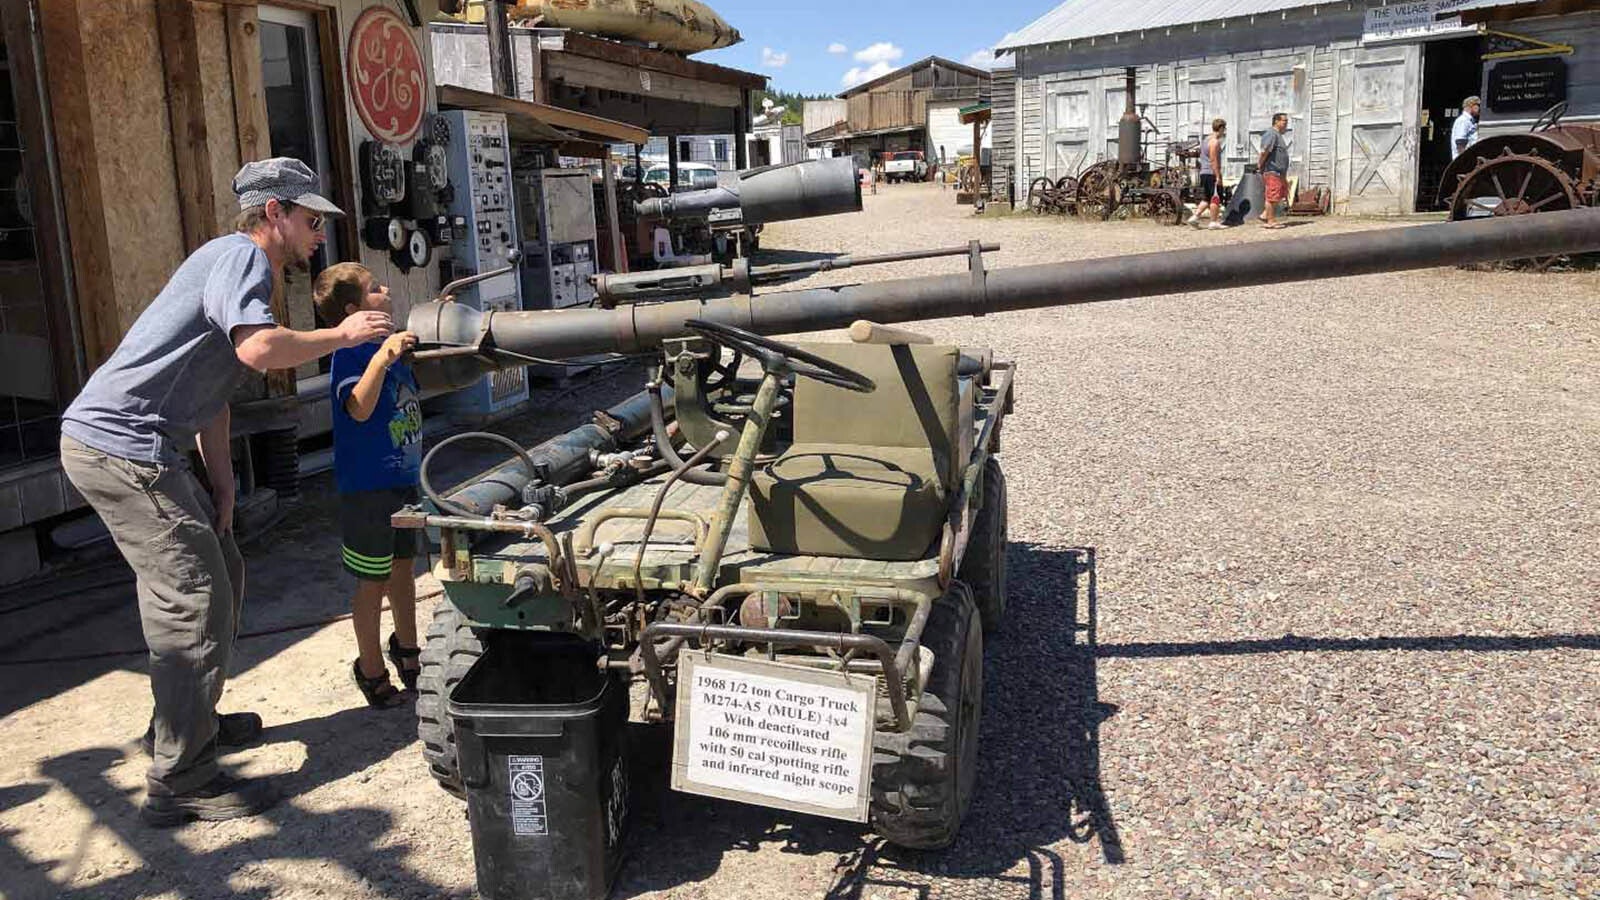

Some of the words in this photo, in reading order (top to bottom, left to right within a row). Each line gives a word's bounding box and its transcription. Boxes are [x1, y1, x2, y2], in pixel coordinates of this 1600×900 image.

[1373, 9, 1390, 18] THE
[1395, 5, 1430, 16] VILLAGE
[698, 676, 725, 690] 1968
[730, 681, 747, 694] 1/2
[752, 686, 771, 698] ton
[776, 689, 814, 706] Cargo
[818, 696, 858, 712] Truck
[703, 693, 760, 712] M274-A5
[768, 704, 821, 724] (MULE)
[826, 714, 848, 727] 4x4
[709, 726, 729, 739] 106
[733, 733, 757, 744] mm
[761, 735, 817, 755] recoilless
[821, 744, 847, 760] rifle
[724, 712, 754, 728] With
[758, 717, 829, 741] deactivated
[700, 741, 726, 755] with
[730, 746, 744, 758] 50
[748, 749, 765, 762] cal
[769, 754, 819, 773] spotting
[823, 761, 850, 777] rifle
[702, 758, 725, 771] and
[729, 760, 779, 780] infrared
[783, 773, 815, 787] night
[820, 781, 854, 795] scope
